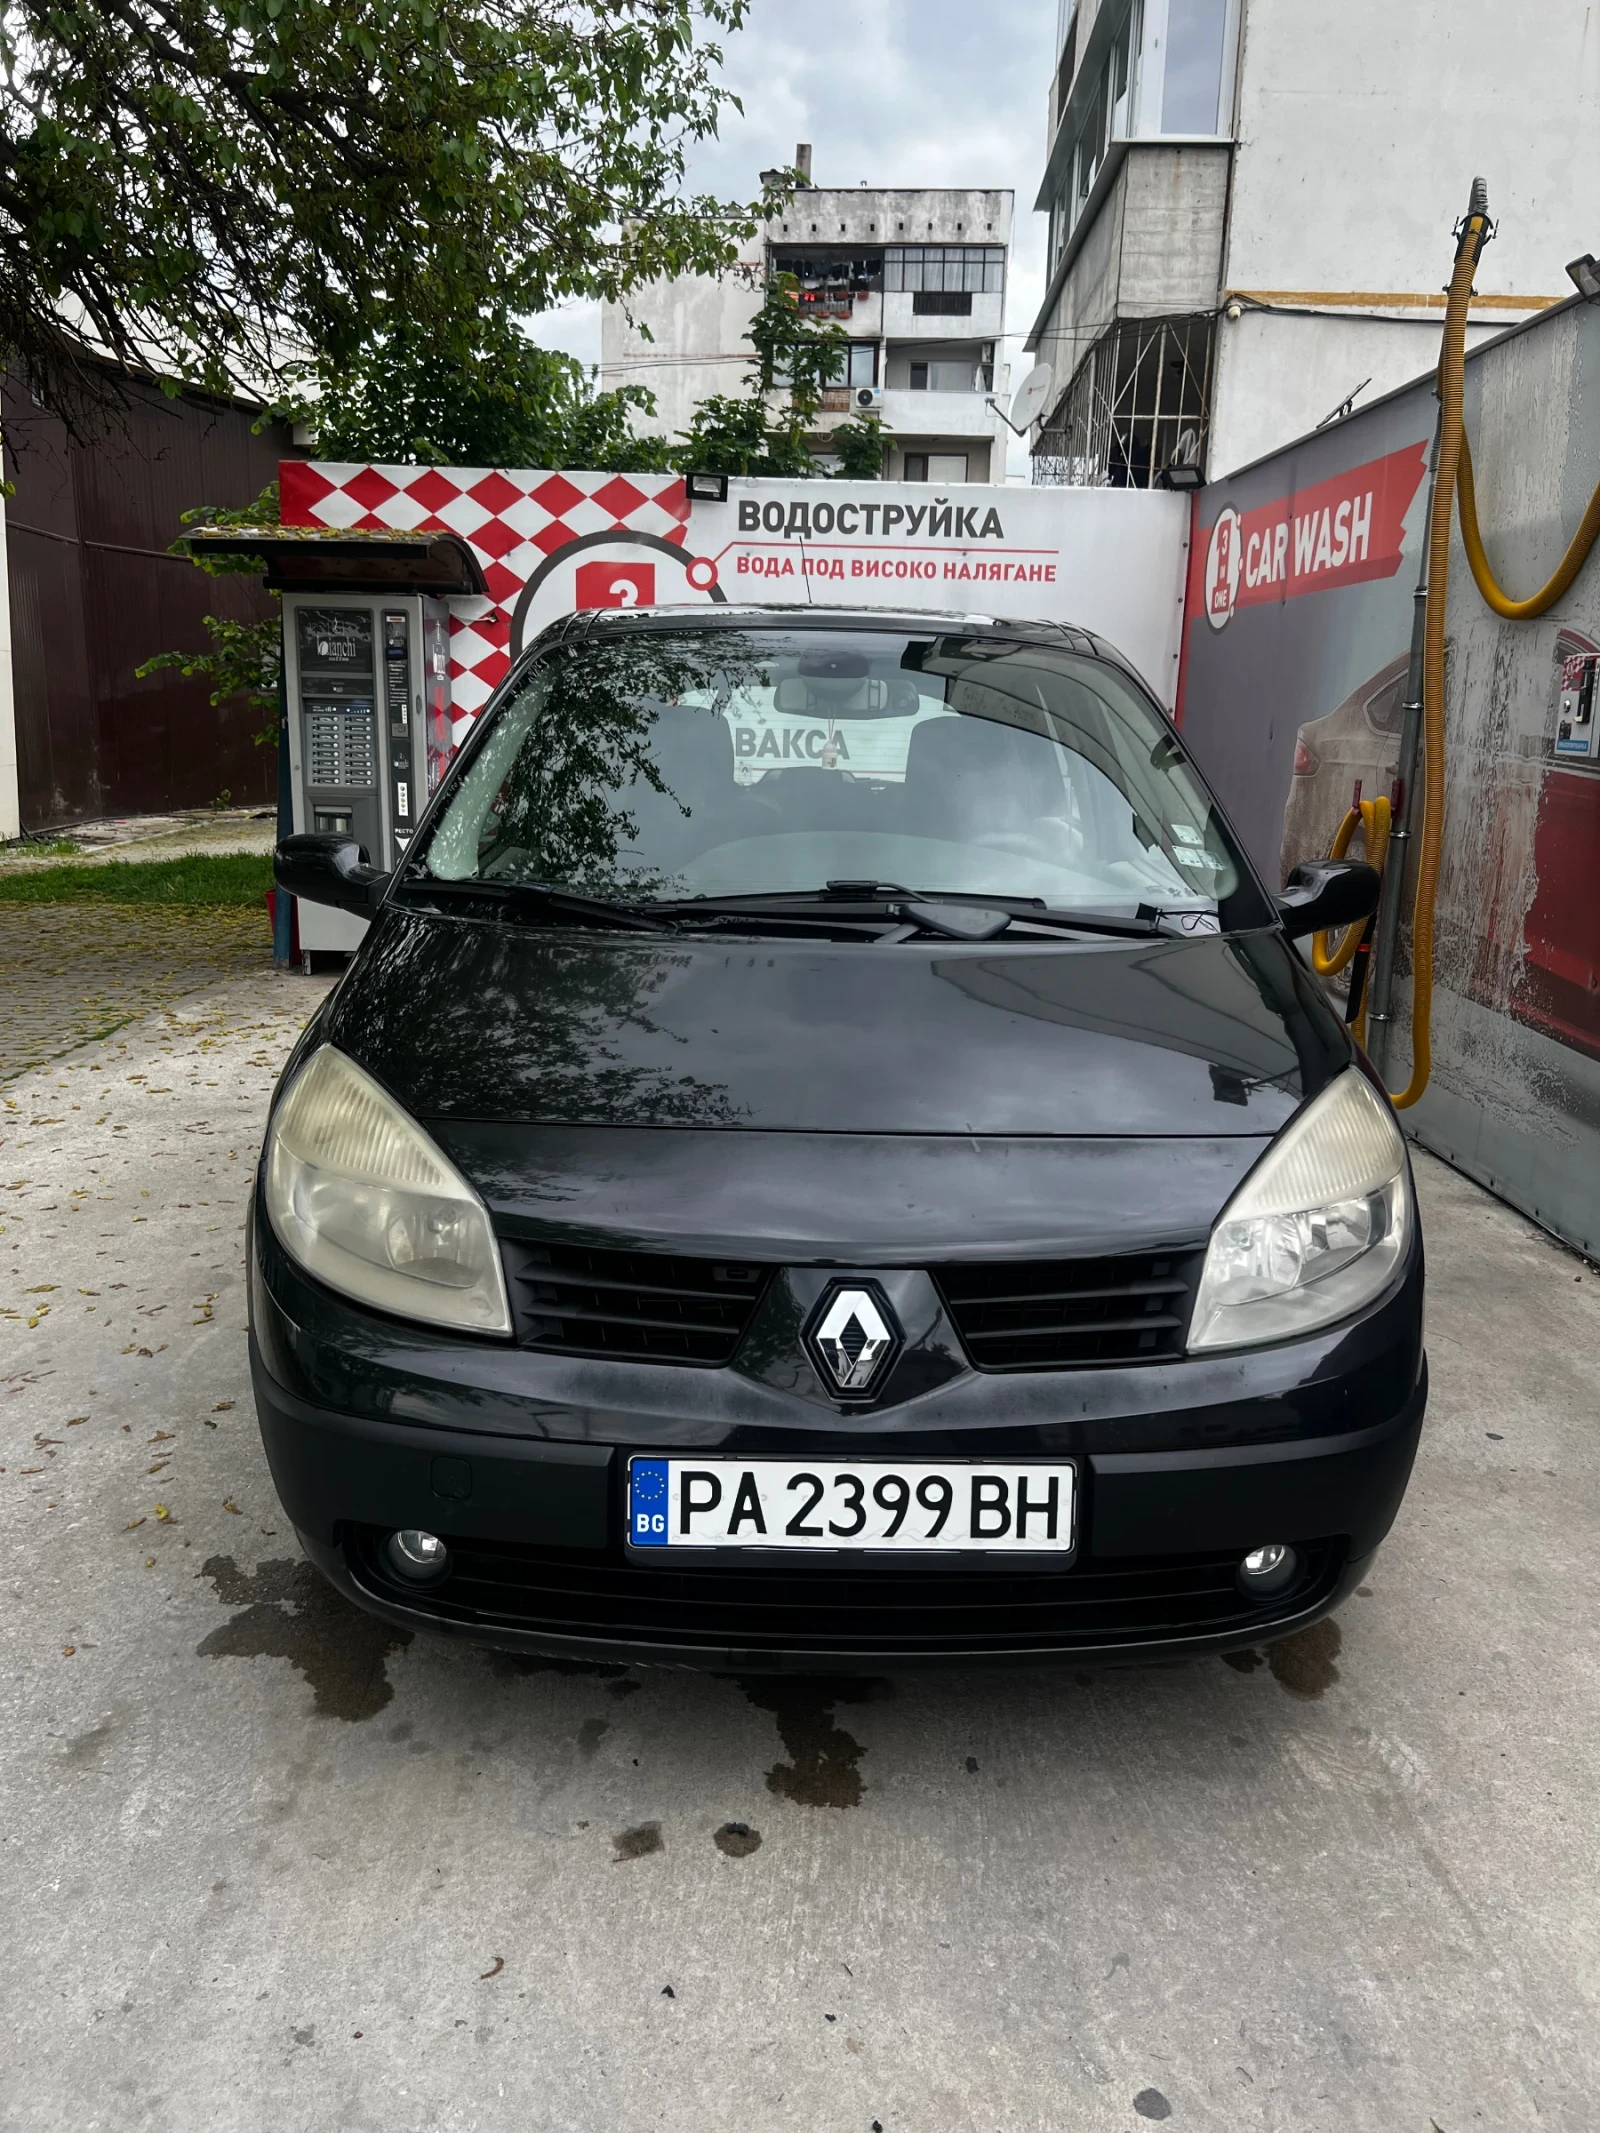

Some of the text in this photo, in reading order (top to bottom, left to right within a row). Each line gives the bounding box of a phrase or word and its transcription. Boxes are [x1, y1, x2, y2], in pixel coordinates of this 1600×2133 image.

[738, 498, 1004, 539] ВОДОСТРУЙКА
[1246, 491, 1373, 588] CAR WASH
[737, 556, 1056, 583] ВОДА ПОД ВИСОКО НАЛЯГАНЕ
[1214, 589, 1228, 609] ONE
[317, 635, 356, 657] bianchi
[735, 727, 850, 760] ВАКСА
[680, 1471, 1059, 1538] PA 2399 BH
[637, 1513, 665, 1533] BG
